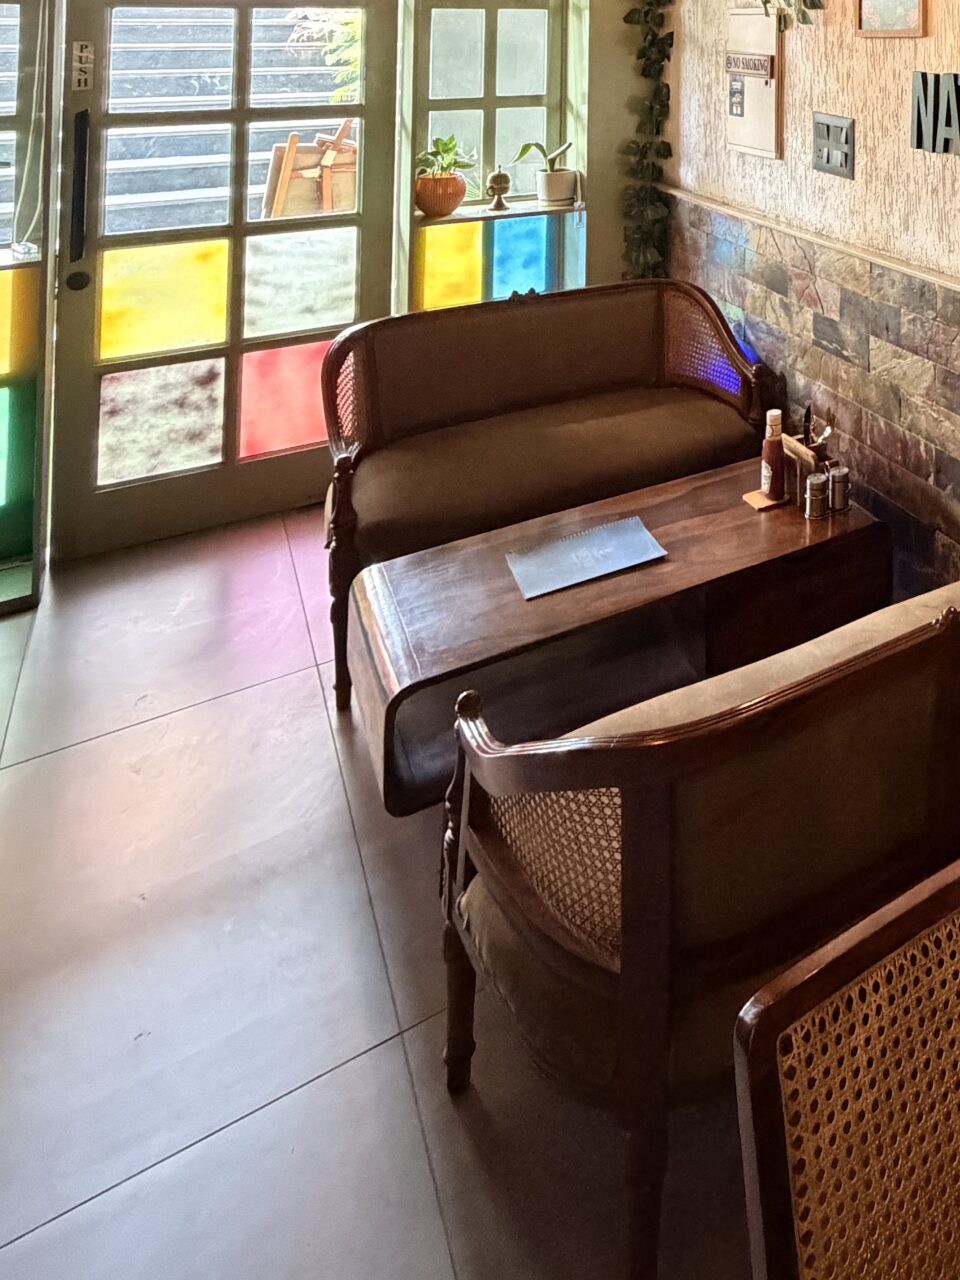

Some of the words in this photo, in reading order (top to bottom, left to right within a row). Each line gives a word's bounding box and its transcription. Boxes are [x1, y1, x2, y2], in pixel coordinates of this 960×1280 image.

[77, 43, 89, 88] PUSH
[732, 56, 741, 69] NO
[741, 57, 768, 72] SMOKING
